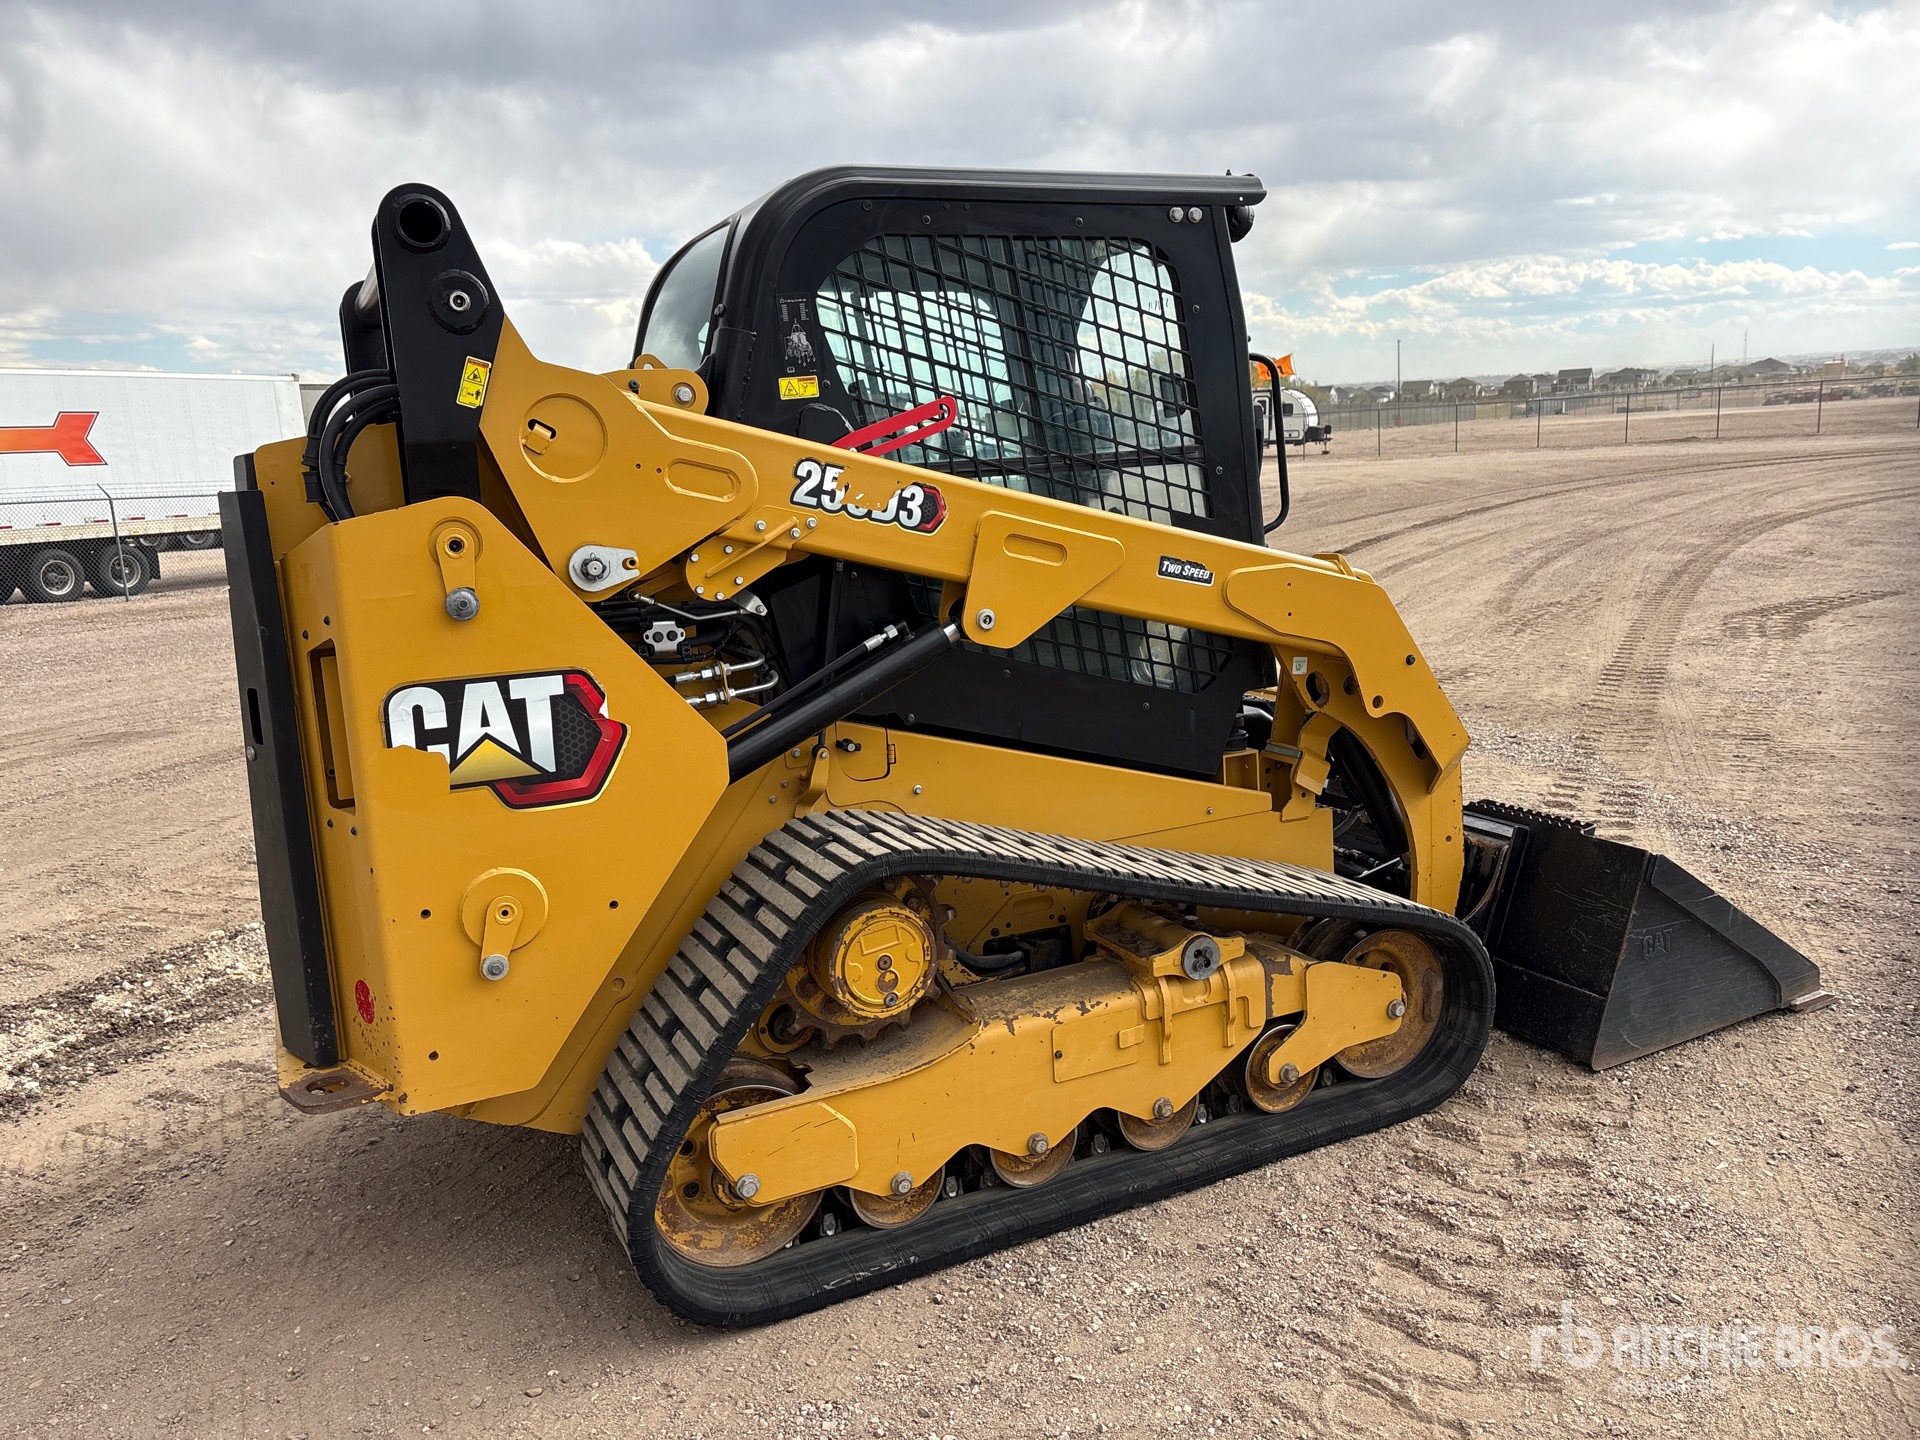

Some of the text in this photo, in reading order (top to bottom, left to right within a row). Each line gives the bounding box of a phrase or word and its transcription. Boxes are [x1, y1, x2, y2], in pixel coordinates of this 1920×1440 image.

[792, 460, 924, 527] 253
[388, 674, 565, 773] CAT
[1642, 929, 1673, 960] CAT
